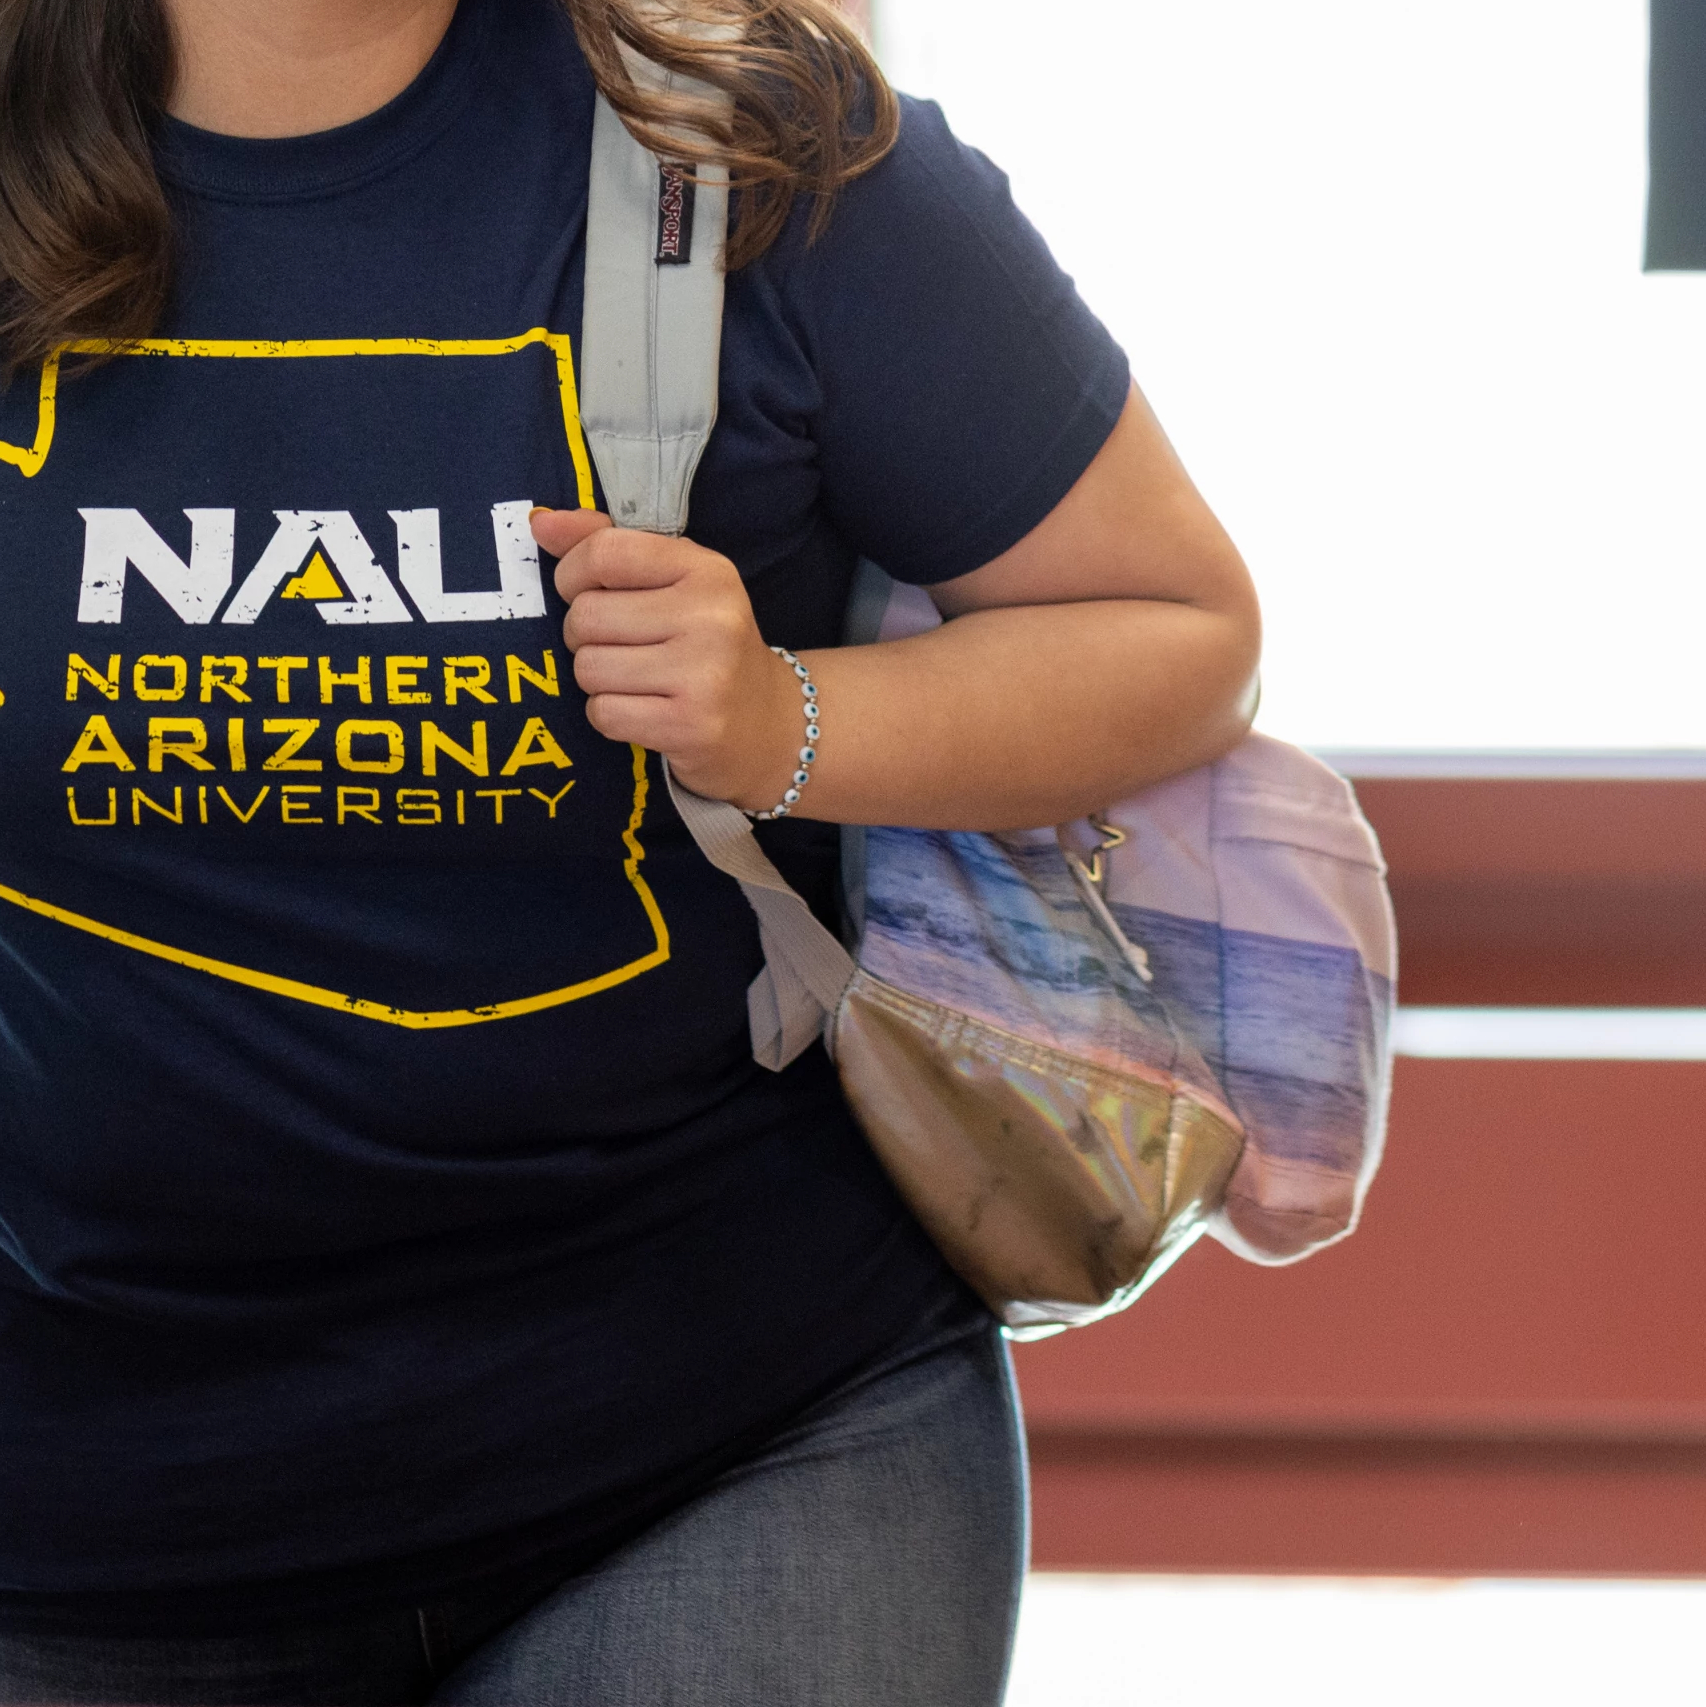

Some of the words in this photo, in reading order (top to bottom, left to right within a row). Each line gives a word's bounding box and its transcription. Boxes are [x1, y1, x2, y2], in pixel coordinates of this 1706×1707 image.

[77, 500, 547, 625] NAU
[65, 649, 560, 705] NORTHERN
[60, 714, 574, 777] ARIZONA
[66, 780, 577, 825] UNIVERSITY
